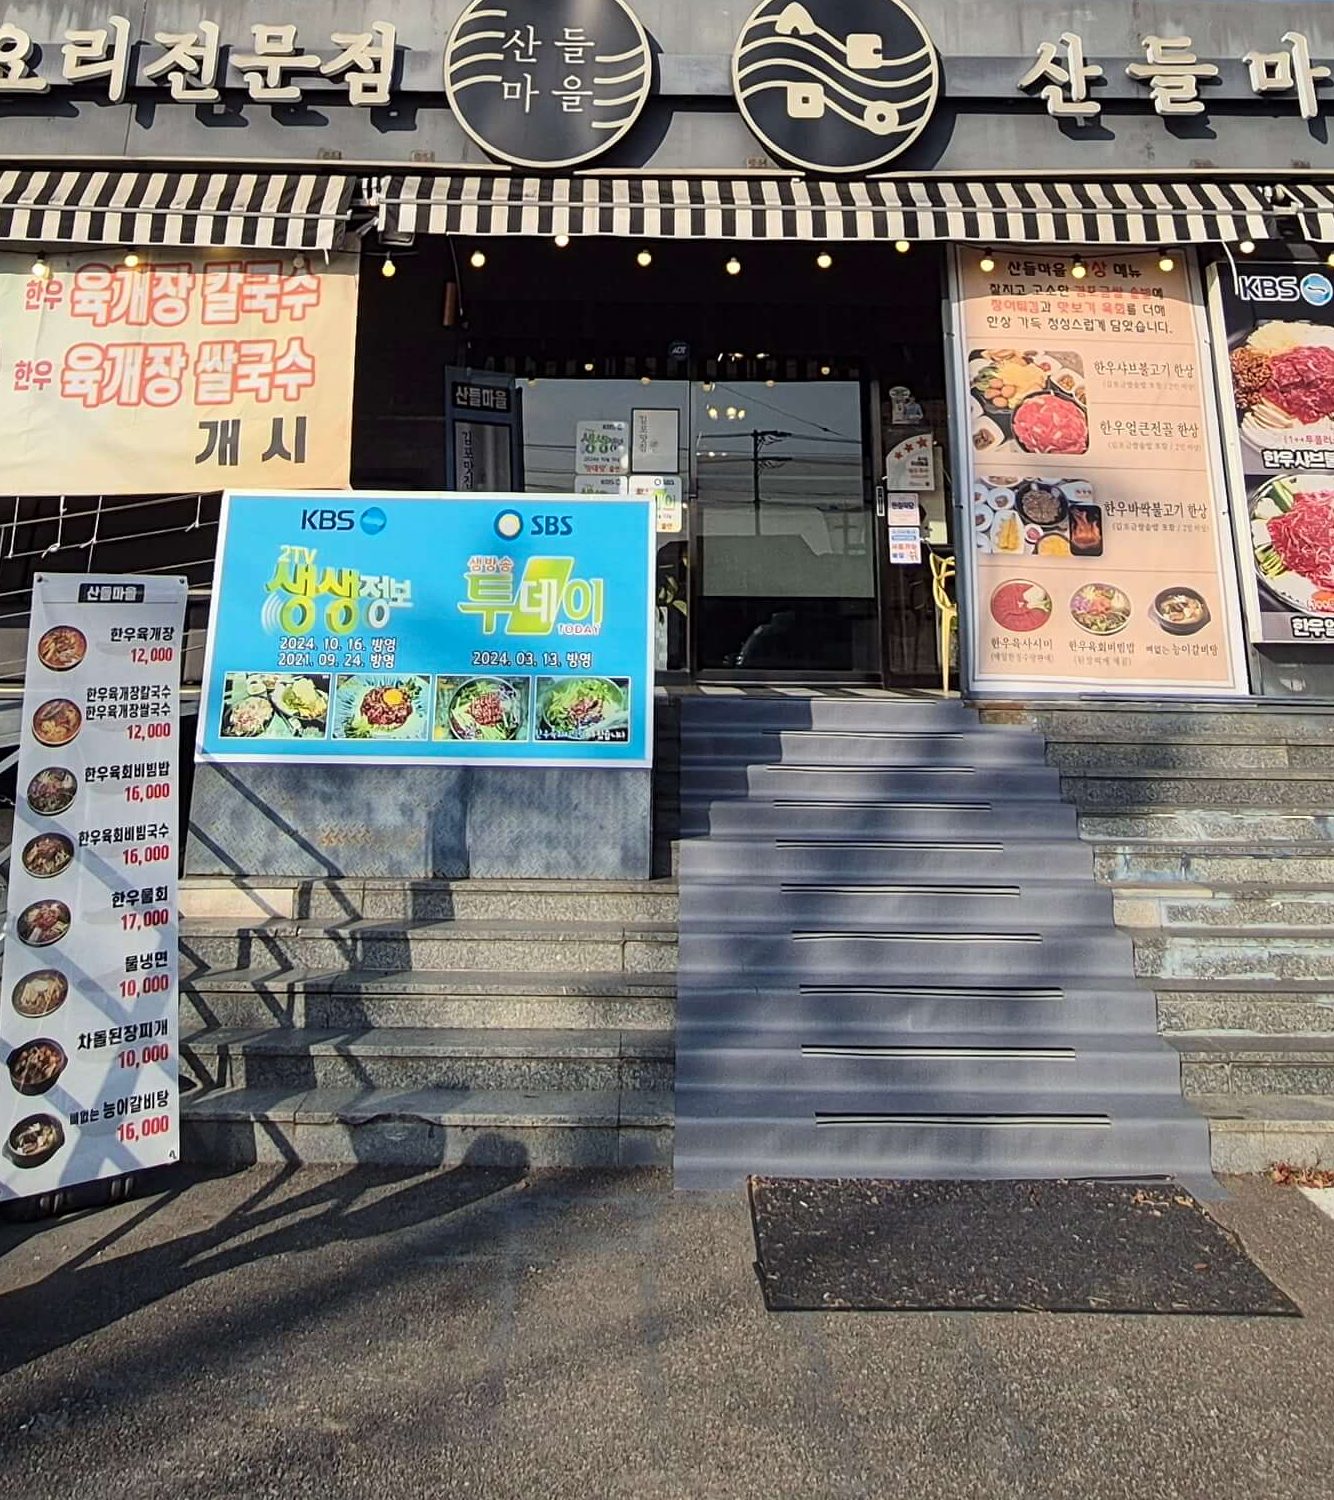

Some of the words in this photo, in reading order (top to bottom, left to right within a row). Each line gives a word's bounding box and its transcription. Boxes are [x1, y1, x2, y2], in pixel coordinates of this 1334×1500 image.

[503, 25, 595, 64] 산들
[503, 73, 593, 113] 마을
[1008, 260, 1066, 278] 산들마을
[1113, 261, 1142, 278] 메뉴
[25, 279, 63, 311] 한우
[71, 264, 193, 327] 육개장
[201, 258, 320, 325] 칼국수
[1239, 276, 1299, 301] KBS
[14, 360, 52, 392] 한우
[61, 342, 187, 407] 육개장
[194, 337, 315, 406] 쌀국수
[455, 385, 508, 409] 산들마을
[300, 509, 355, 531] KBS
[531, 515, 573, 536] SBS
[467, 556, 513, 572] 생방송
[266, 563, 413, 635] 생생정보
[458, 570, 603, 634] 투데이
[110, 626, 174, 643] 한우육개장
[557, 624, 601, 636] TODAY
[130, 647, 172, 665] 12,000
[323, 637, 342, 651] 10.
[347, 637, 366, 651] 16.
[371, 637, 397, 653] 방영
[318, 653, 339, 667] 09.
[343, 653, 365, 667] 24.
[370, 653, 395, 668] 방영
[516, 652, 537, 666] 03.
[566, 652, 592, 668] 방영
[86, 684, 171, 702] 한우육개장칼국수
[126, 723, 171, 742] 12,000
[84, 761, 170, 783] 한우육회비빔밥
[124, 783, 170, 802] 16,000
[122, 845, 169, 867] 16,000
[121, 909, 168, 932] 17,000
[124, 951, 168, 973] 물냉면
[119, 975, 169, 999] 10,000
[118, 1043, 169, 1069] 10,000
[117, 1115, 169, 1142] 16,000
